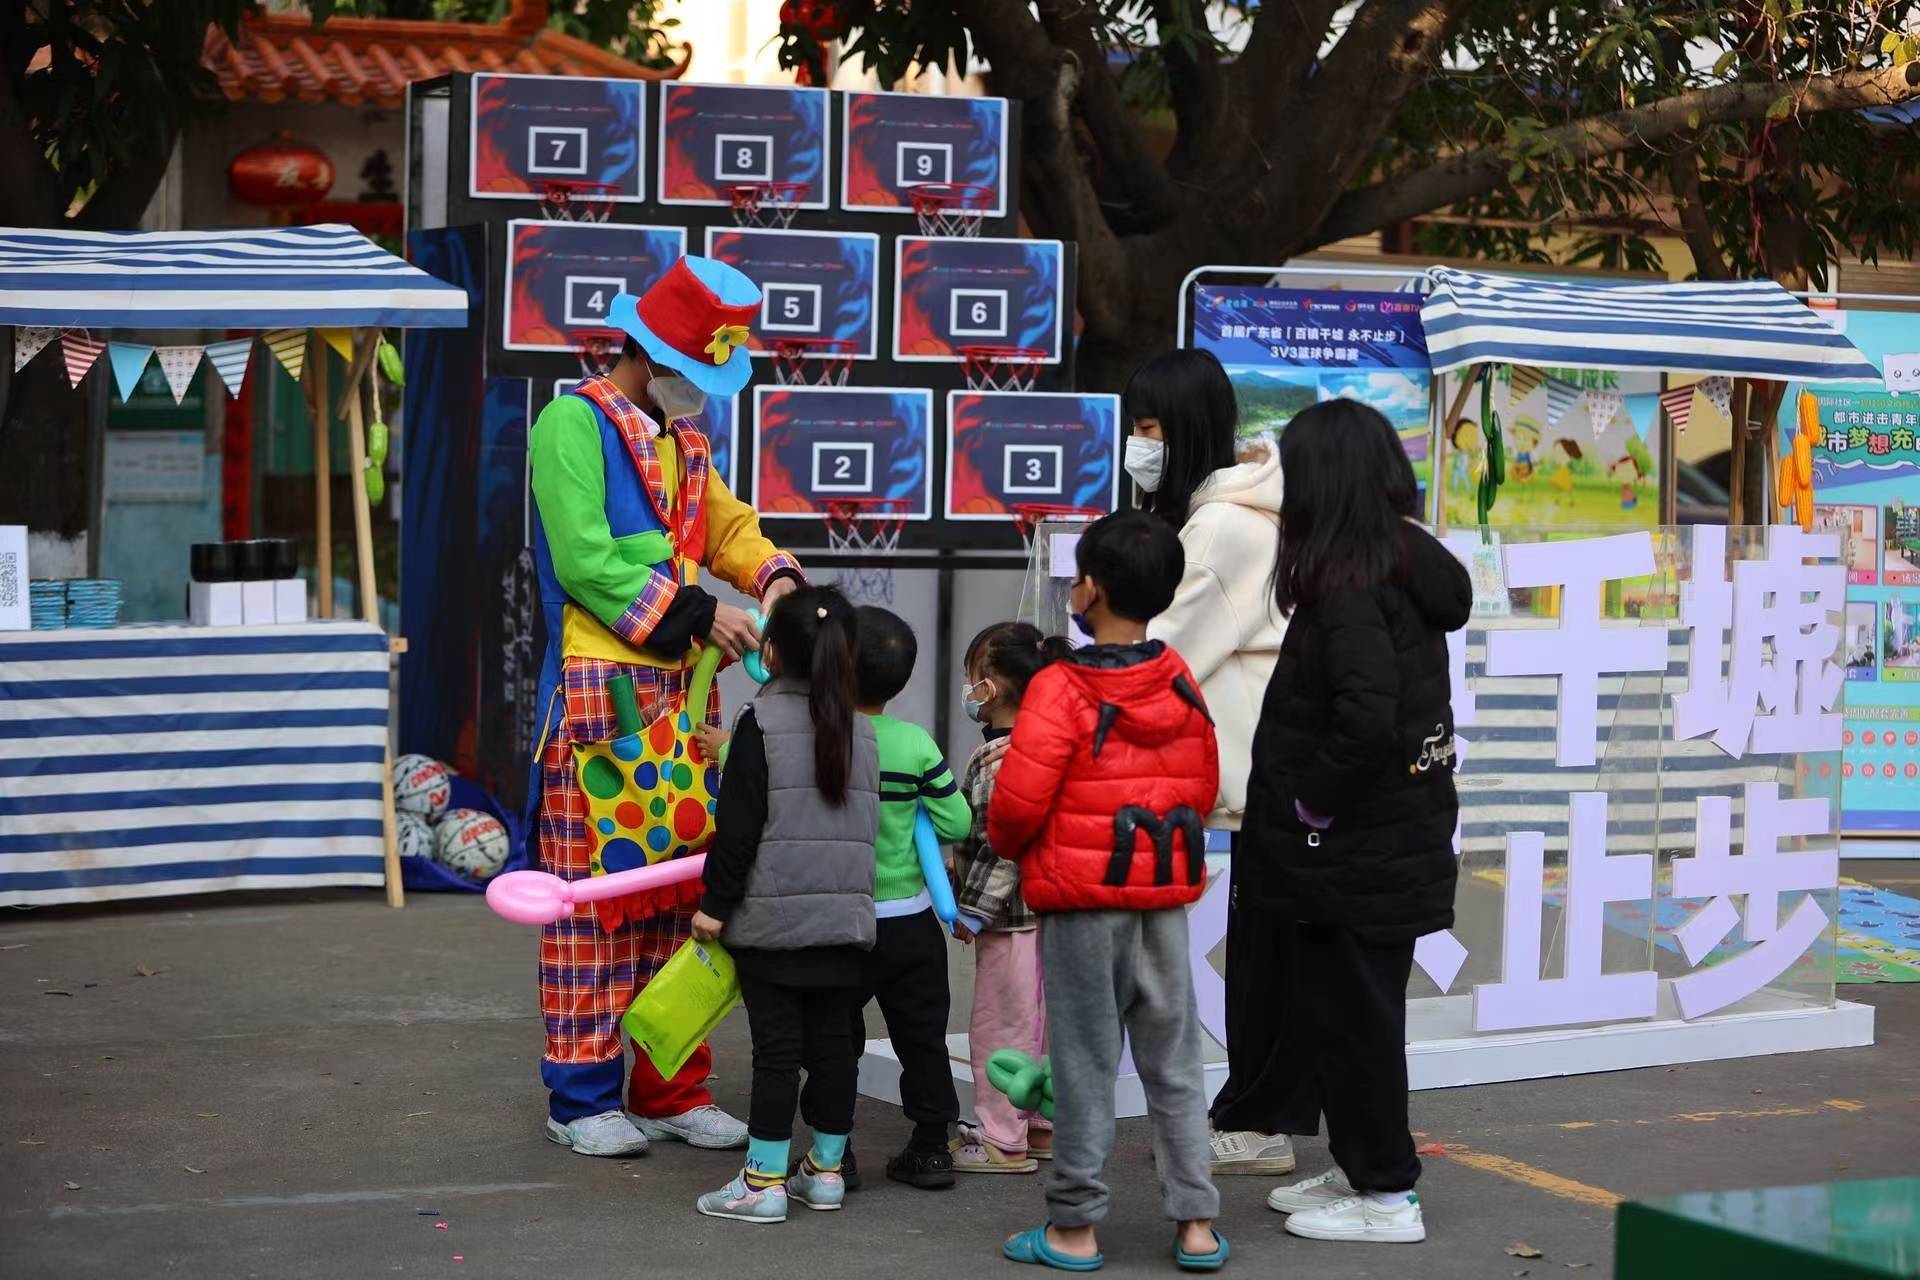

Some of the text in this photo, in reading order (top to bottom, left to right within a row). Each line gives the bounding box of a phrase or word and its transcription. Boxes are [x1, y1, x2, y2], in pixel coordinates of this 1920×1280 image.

[550, 140, 567, 161] 7
[735, 147, 753, 170] 8
[916, 153, 933, 176] 9
[587, 290, 605, 312] 4
[783, 296, 800, 319] 5
[970, 301, 988, 324] 6
[1833, 410, 1917, 427] 都市进击青年
[1819, 426, 1920, 454] 市梦想充
[833, 455, 851, 479] 2
[1024, 458, 1042, 481] 3
[1414, 781, 1838, 1033] 止步
